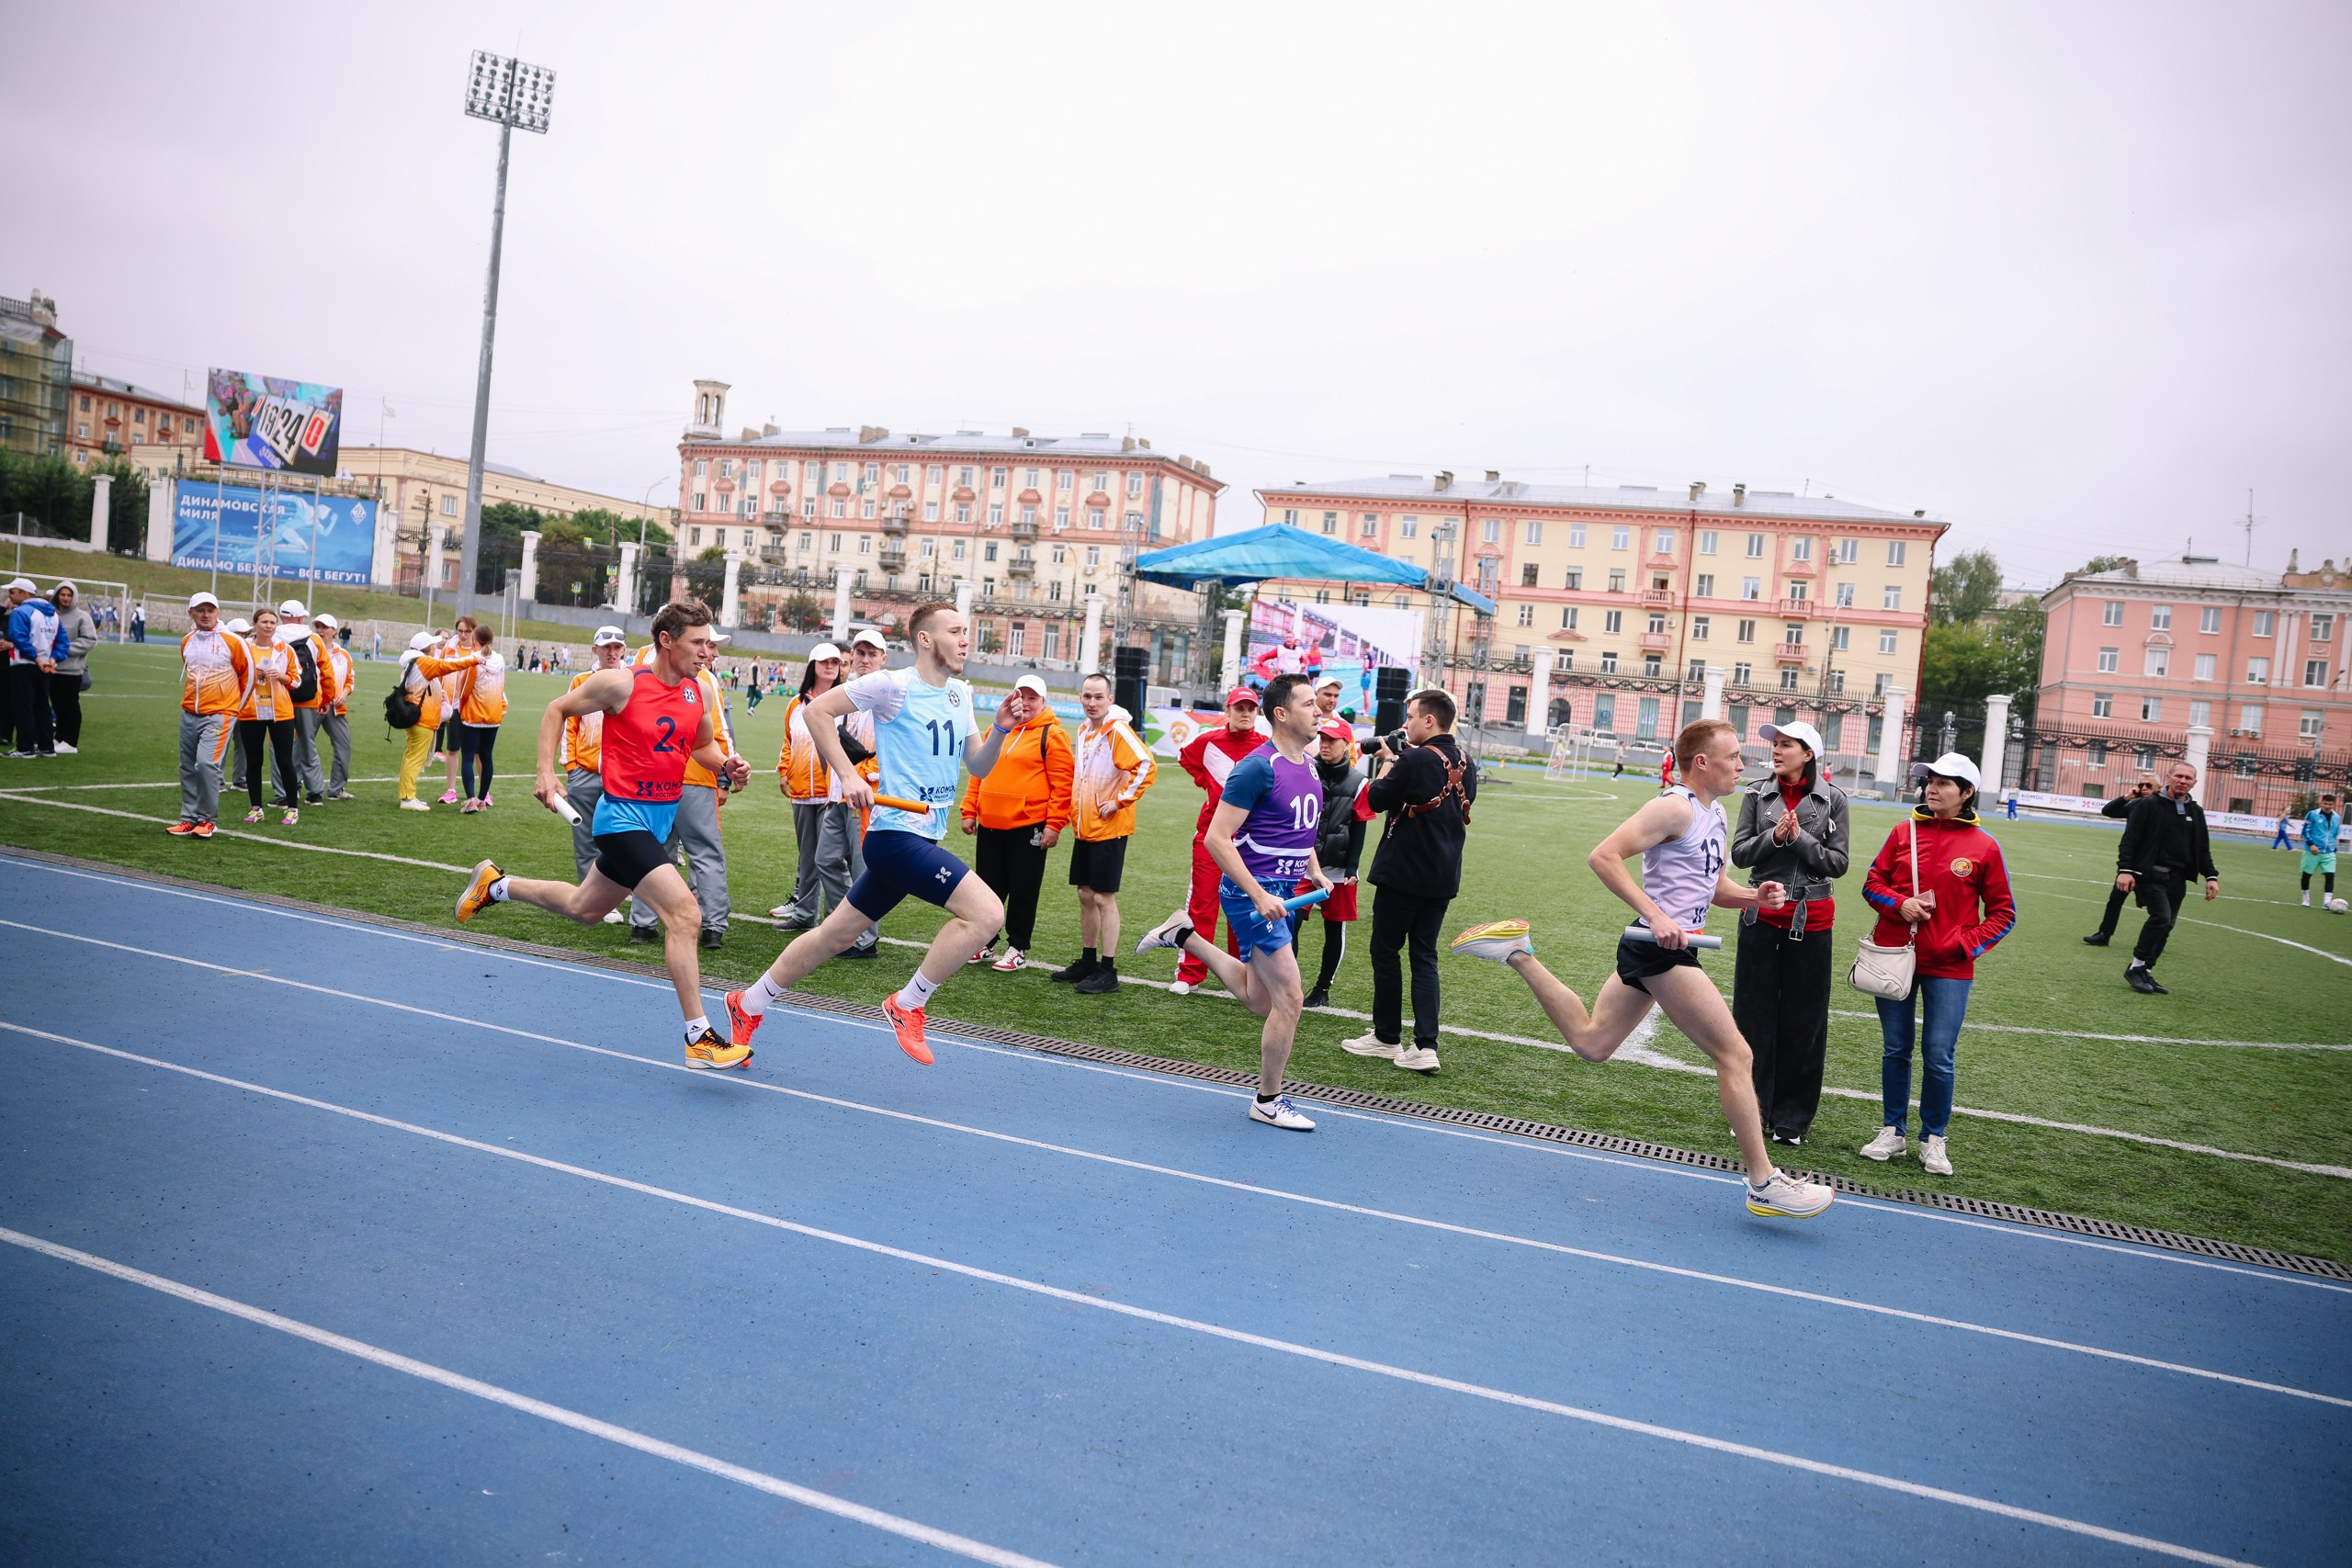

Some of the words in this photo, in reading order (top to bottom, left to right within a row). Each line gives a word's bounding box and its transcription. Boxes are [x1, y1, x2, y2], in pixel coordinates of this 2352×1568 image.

[179, 507, 219, 521] МИЛЯ
[180, 494, 286, 514] ДИНАМОВСКАЯ
[175, 556, 234, 570] ДИНАМО
[237, 562, 280, 575] БЕЖИТ
[324, 570, 366, 583] БЕГУТ!
[653, 716, 676, 752] 2
[925, 718, 955, 756] 11
[1289, 793, 1318, 830] 10
[1747, 1191, 1770, 1204] HOKA
